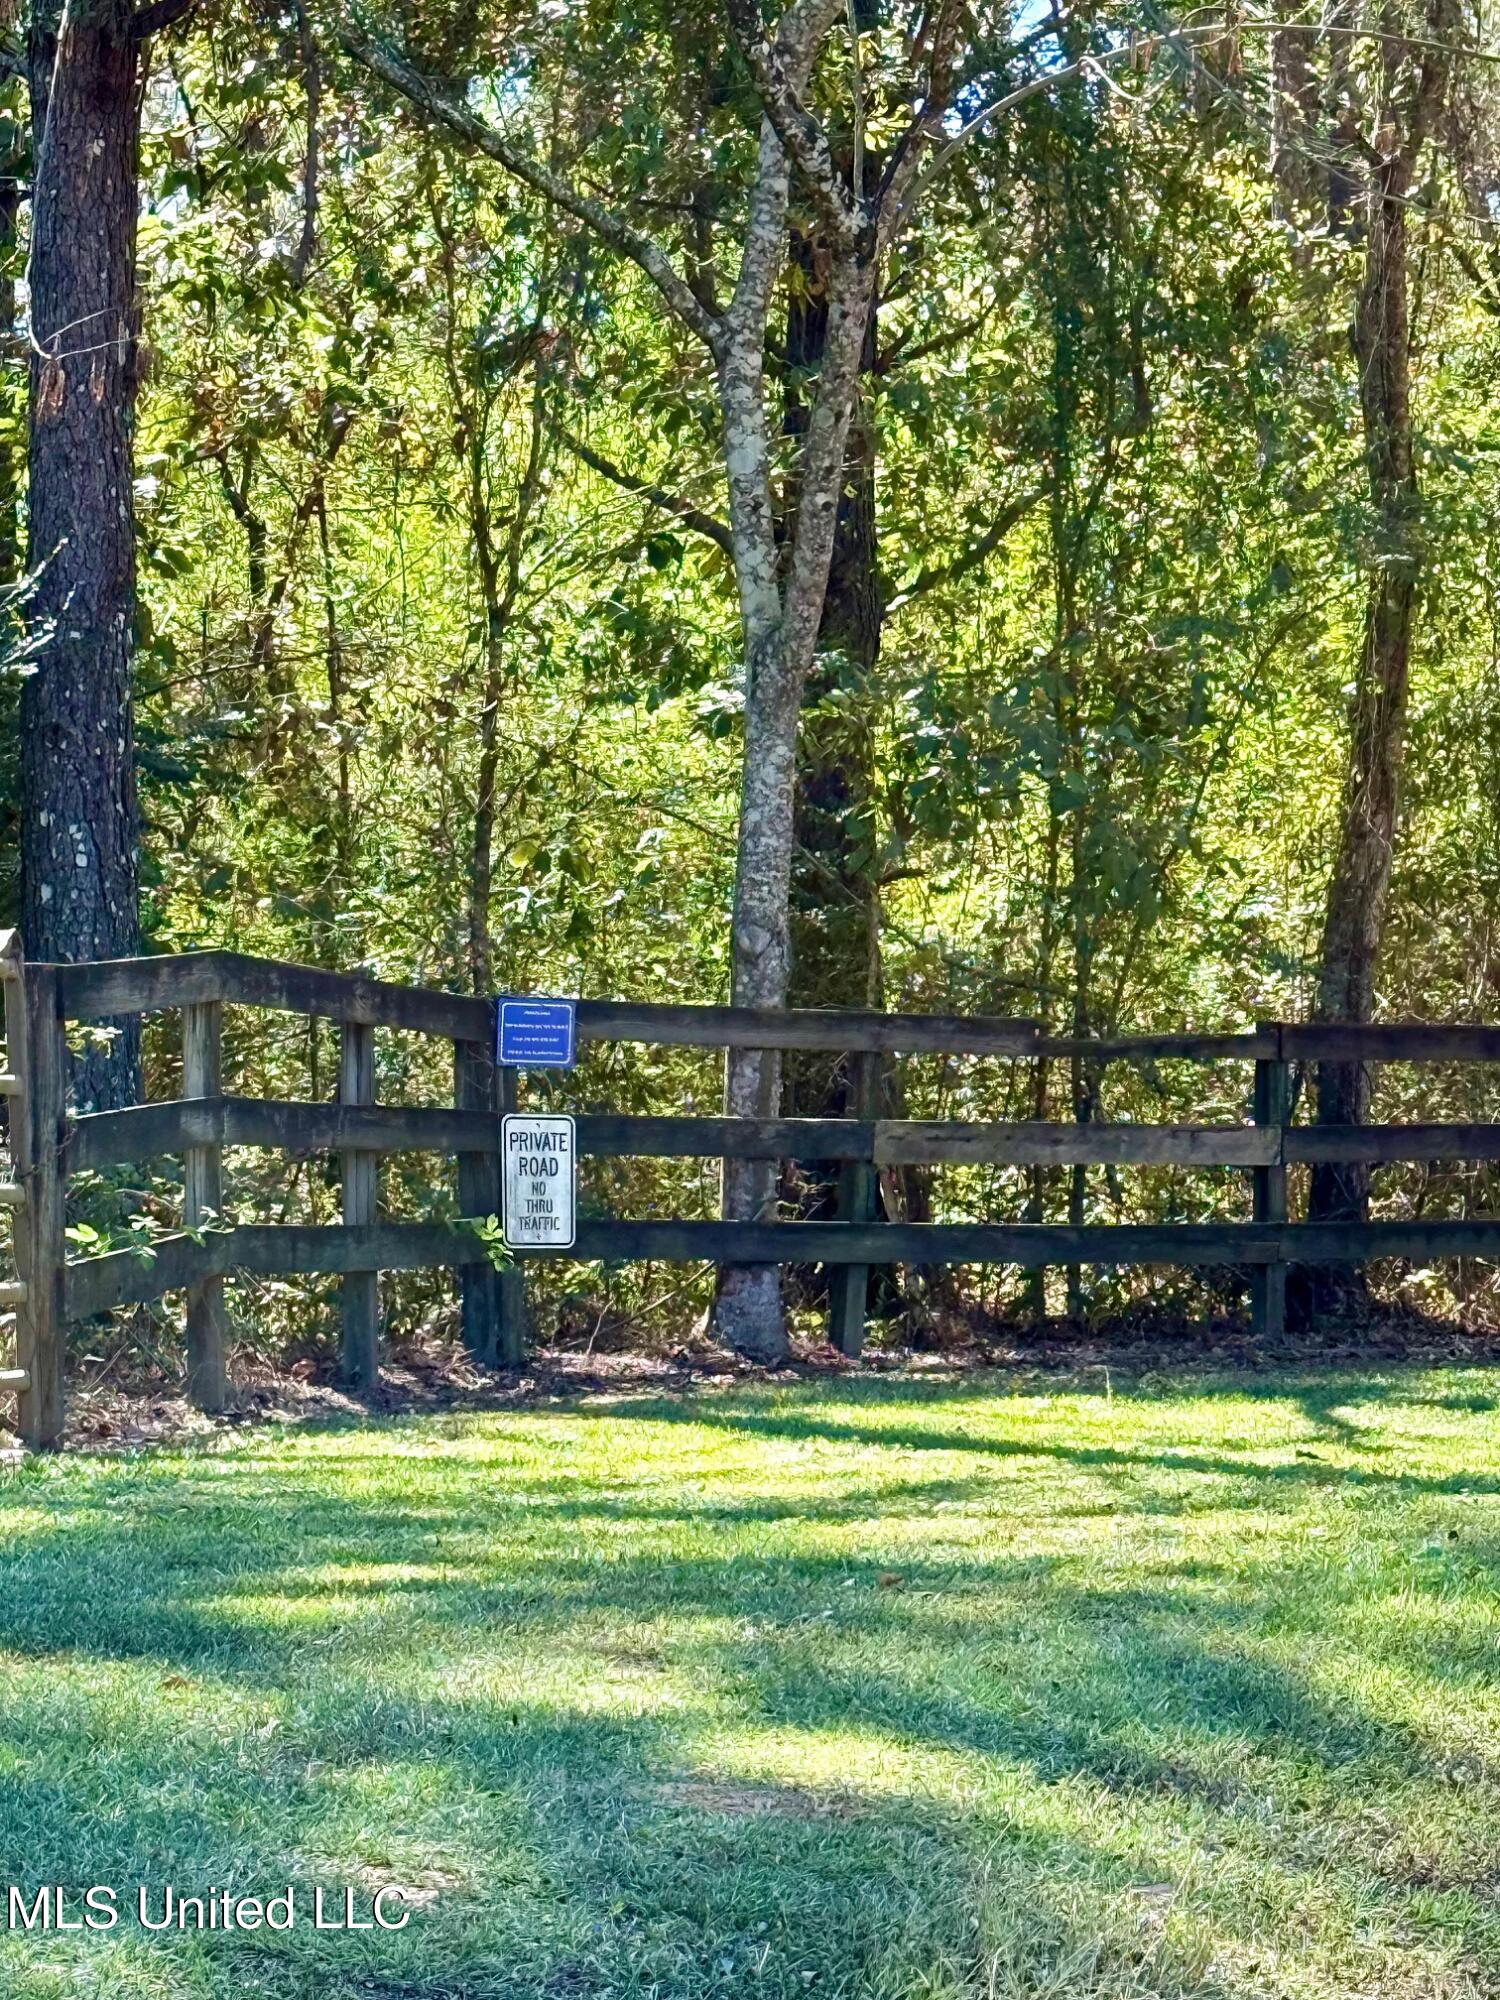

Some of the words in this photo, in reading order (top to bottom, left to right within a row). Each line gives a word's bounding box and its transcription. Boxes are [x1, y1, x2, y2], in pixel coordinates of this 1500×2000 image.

[509, 1131, 568, 1152] PRIVATE
[519, 1156, 559, 1177] ROAD
[531, 1181, 547, 1196] NO
[525, 1199, 554, 1213] THRU
[519, 1216, 560, 1230] TRAFFIC
